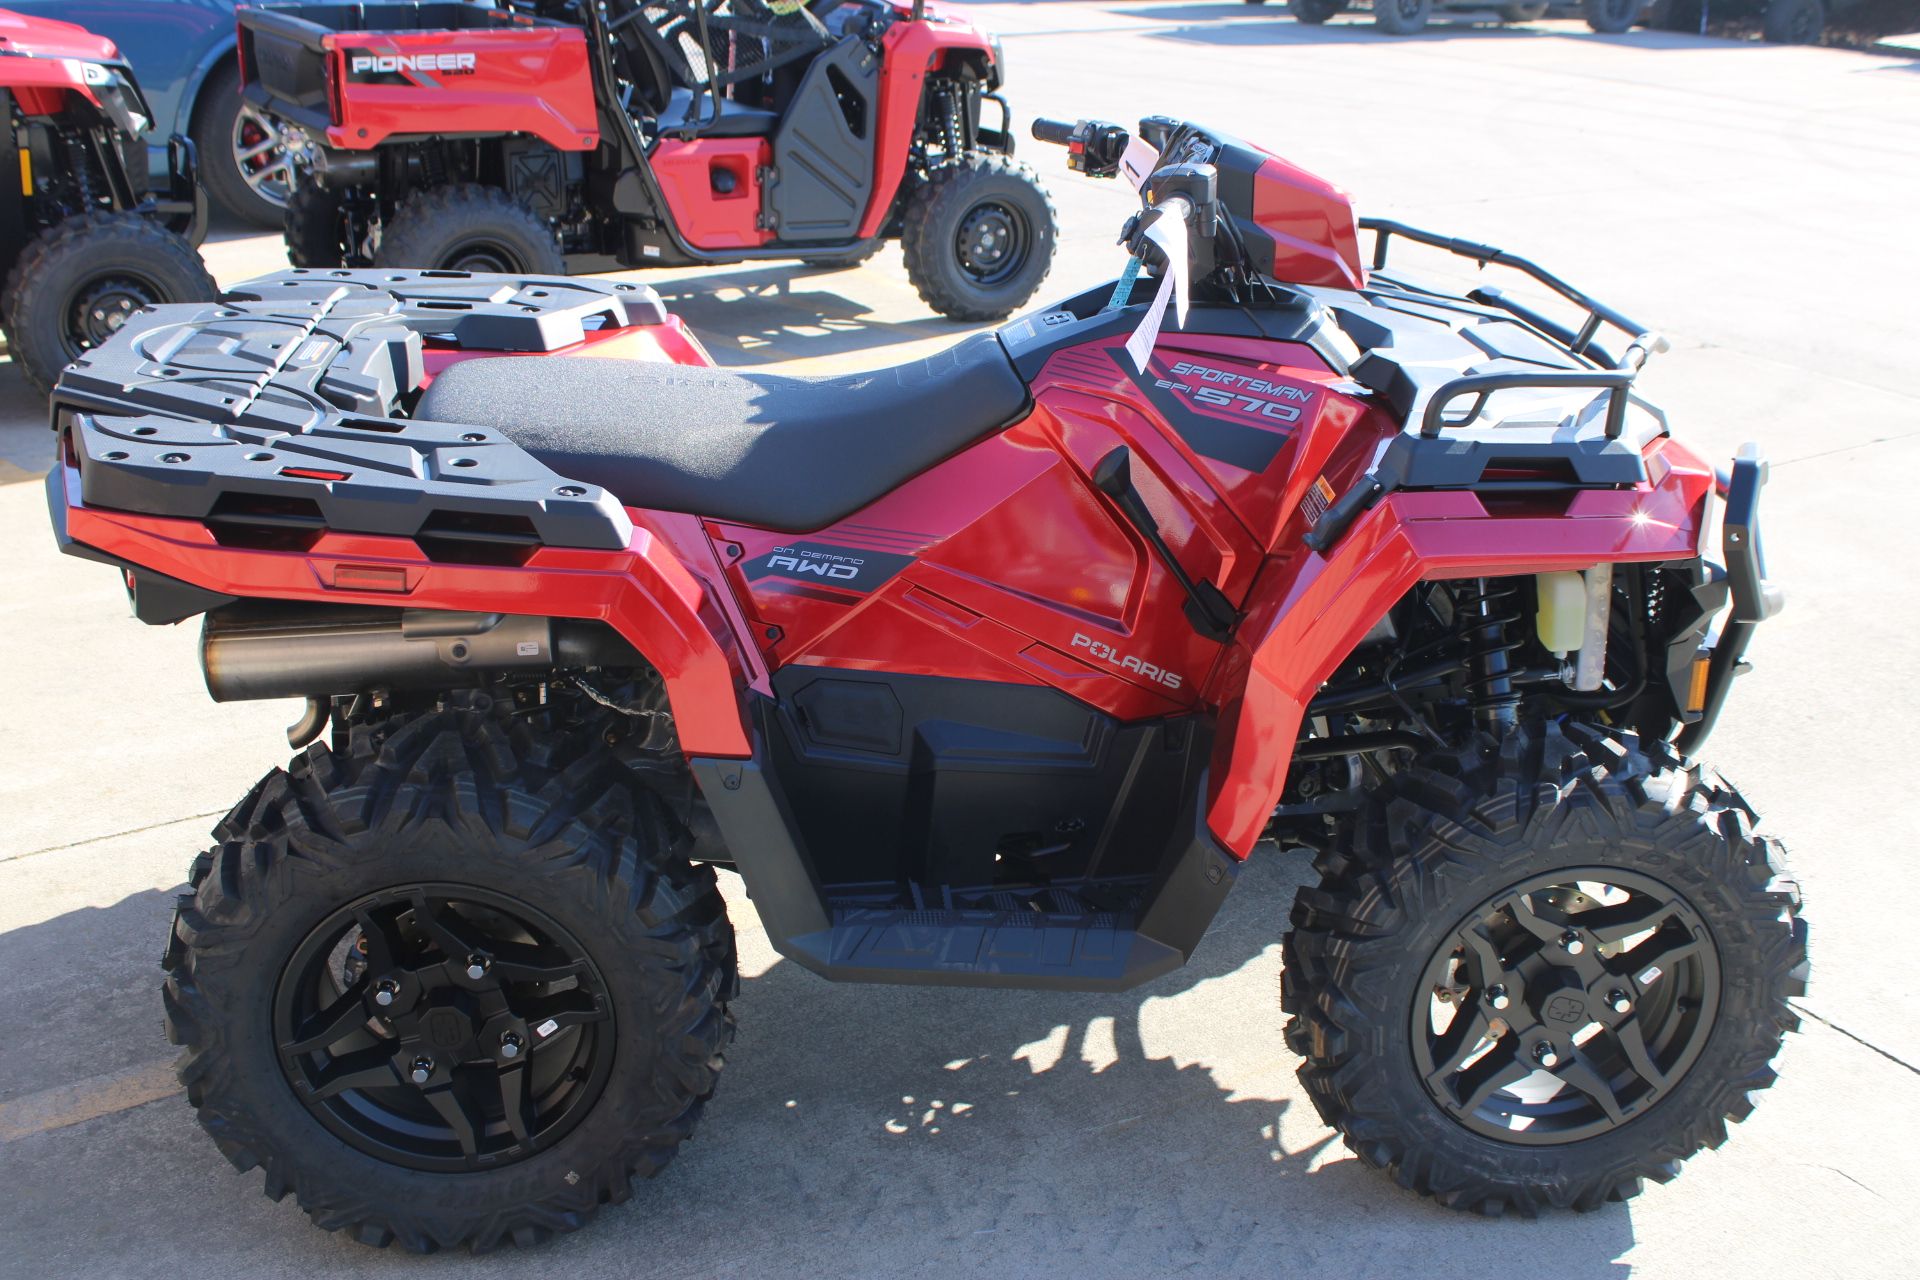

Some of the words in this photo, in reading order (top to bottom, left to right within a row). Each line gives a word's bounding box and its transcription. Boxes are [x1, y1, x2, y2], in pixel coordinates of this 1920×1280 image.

[352, 53, 476, 74] PIONEER
[1170, 362, 1314, 402] SPORTSMAN
[1154, 379, 1192, 394] EFI
[1194, 387, 1301, 422] 570
[767, 555, 859, 580] AWD
[801, 550, 864, 565] DEMAND
[1071, 632, 1182, 689] POLARIS
